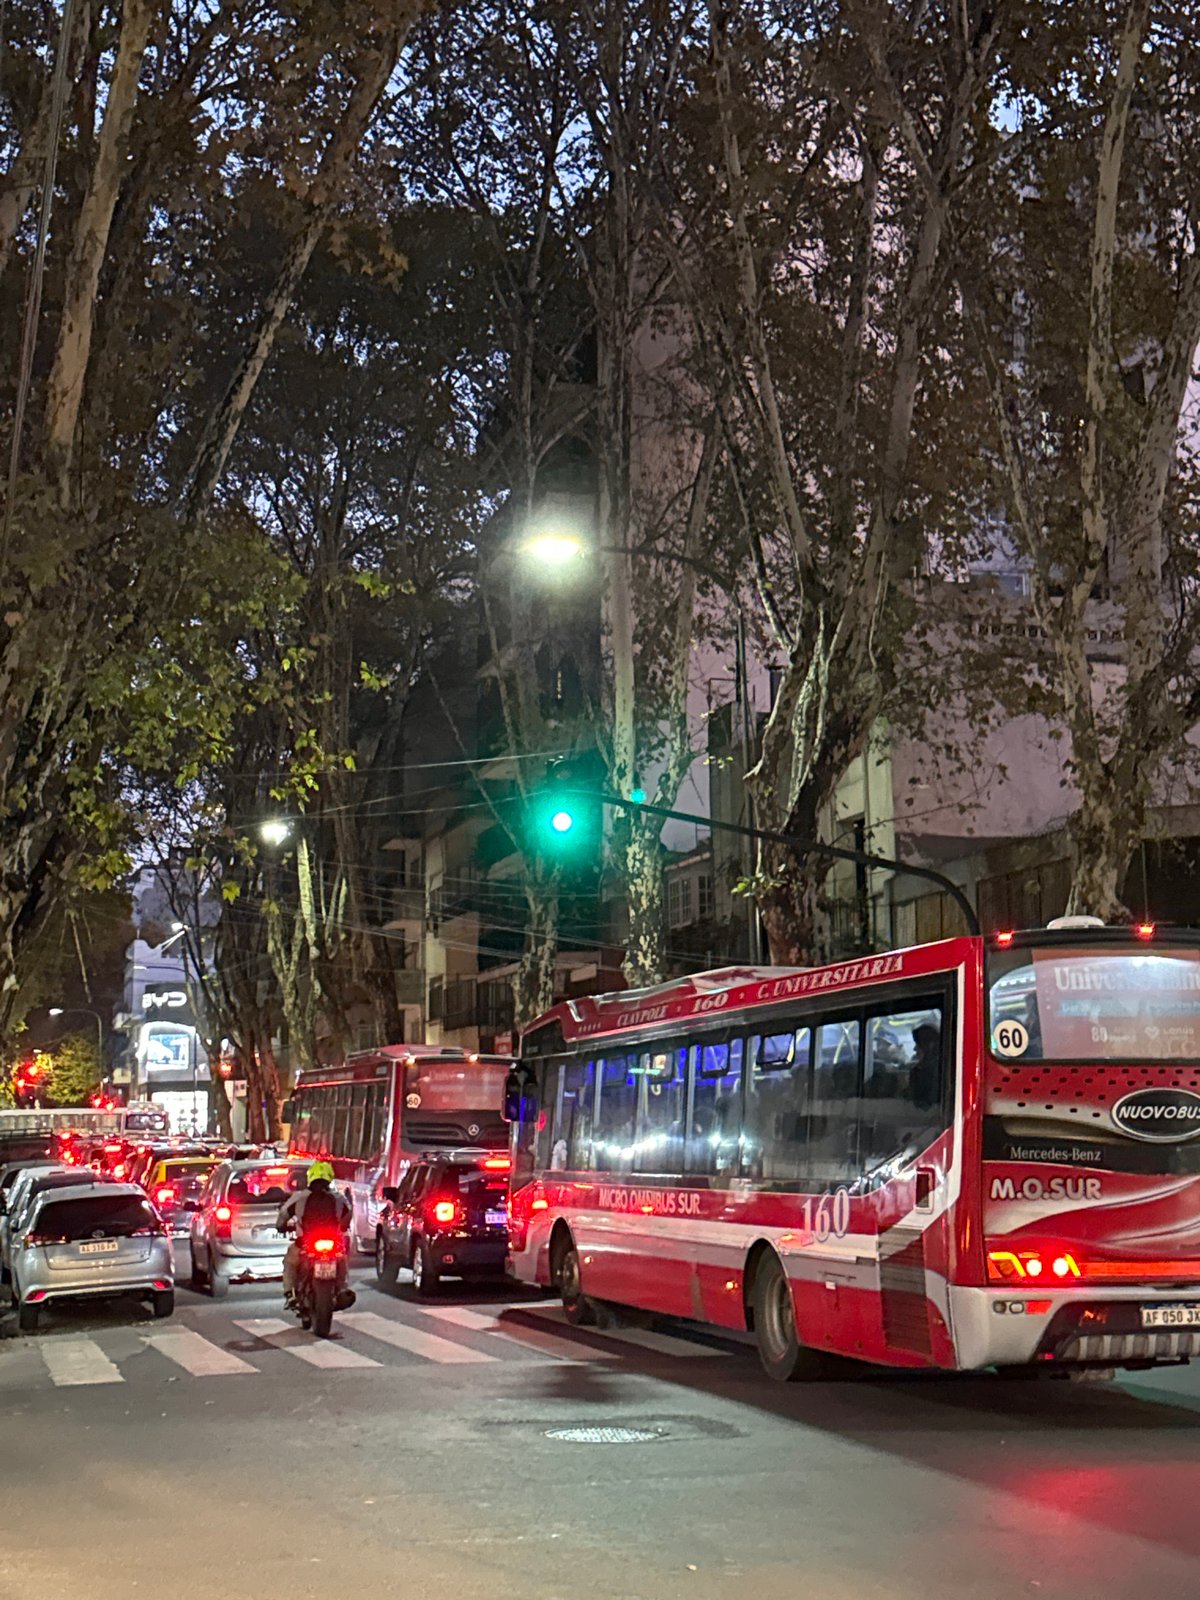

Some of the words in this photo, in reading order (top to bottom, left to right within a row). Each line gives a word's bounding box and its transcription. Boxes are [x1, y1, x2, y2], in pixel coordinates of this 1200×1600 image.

[142, 991, 188, 1008] BYD
[617, 1004, 669, 1027] CLAYPOLE
[691, 992, 728, 1012] 160
[772, 955, 904, 996] UNIVERSITARIA
[998, 1027, 1023, 1049] 60
[407, 1096, 419, 1106] 60
[1010, 1146, 1101, 1161] Mercedes-Benz
[991, 1177, 1102, 1200] M.O.SUR
[599, 1188, 628, 1209] MICRO
[630, 1190, 676, 1214] OMNIBUS
[678, 1193, 701, 1215] SUR
[800, 1184, 850, 1248] 160
[1145, 1311, 1158, 1325] AF
[1162, 1310, 1184, 1323] 050
